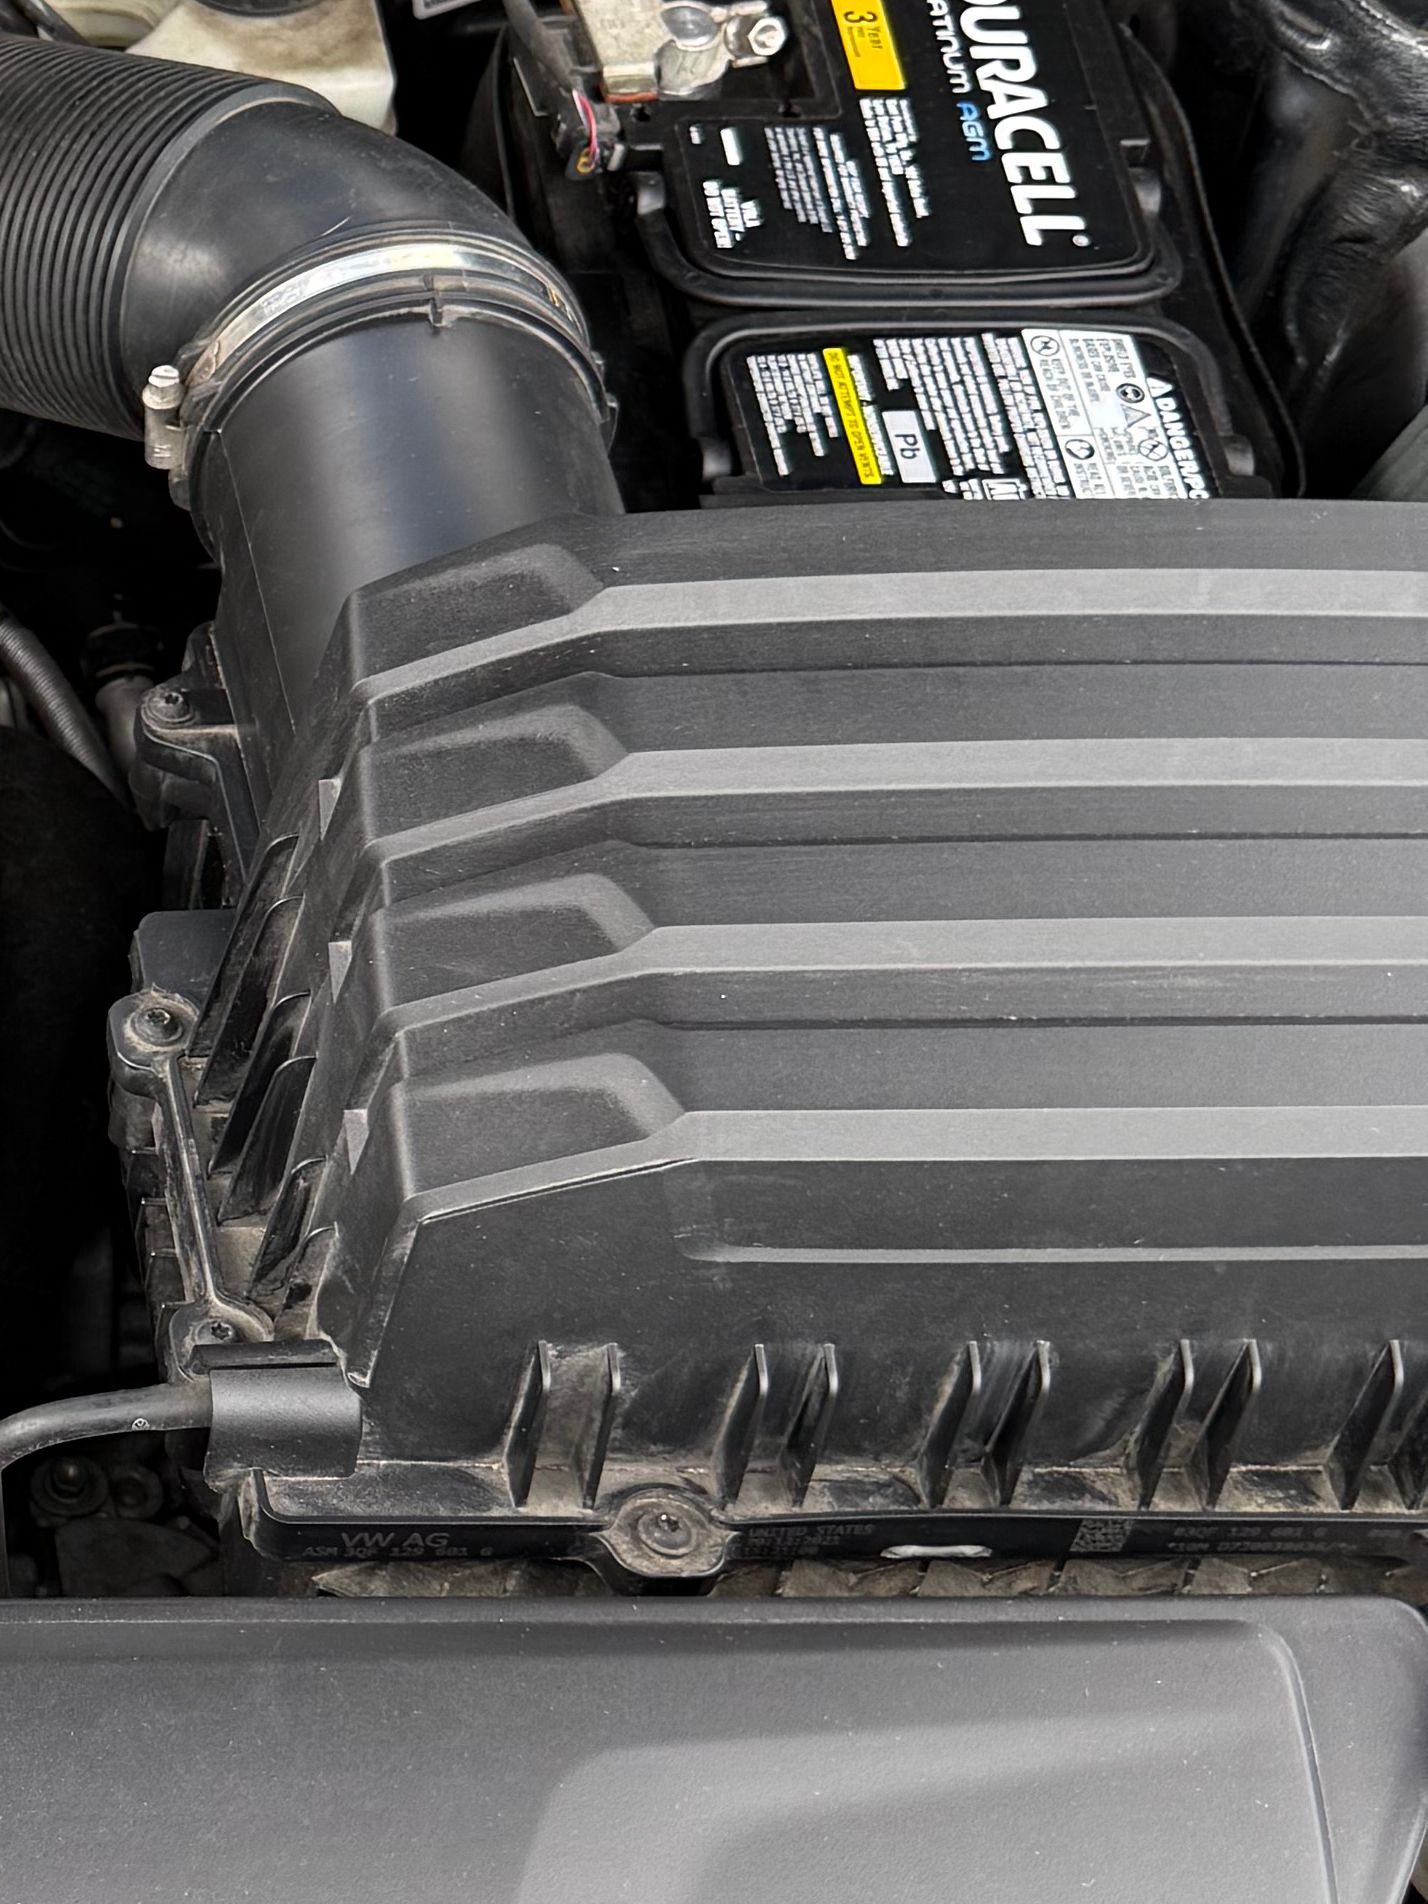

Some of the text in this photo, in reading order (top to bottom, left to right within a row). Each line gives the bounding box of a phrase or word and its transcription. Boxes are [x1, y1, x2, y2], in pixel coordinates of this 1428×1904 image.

[844, 10, 877, 24] 3
[957, 101, 991, 161] AGM
[895, 433, 919, 460] Pb
[341, 1532, 450, 1548] VW AG
